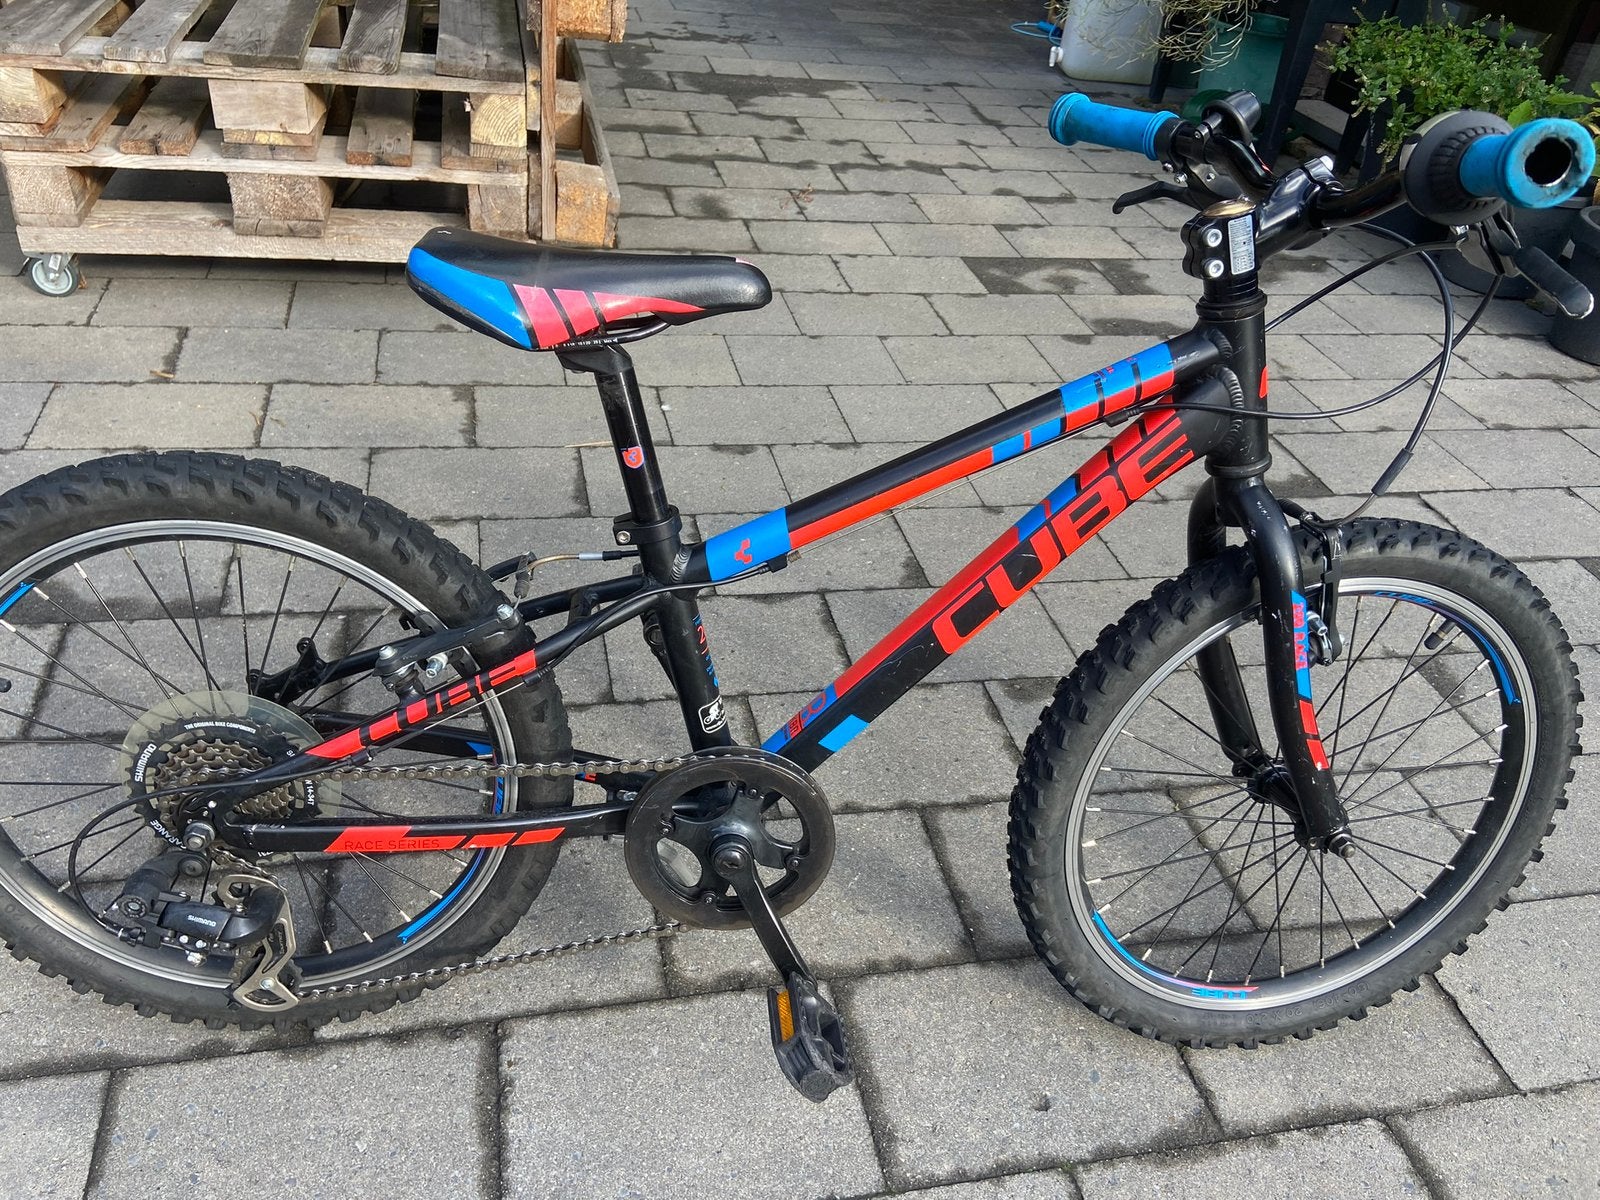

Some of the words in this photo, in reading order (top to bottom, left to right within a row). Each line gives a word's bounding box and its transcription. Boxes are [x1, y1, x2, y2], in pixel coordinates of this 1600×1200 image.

[931, 417, 1195, 655] CUBE
[194, 721, 215, 729] ORIGINAL
[134, 743, 157, 782] SHIMANO
[344, 840, 384, 850] RACE
[388, 839, 440, 849] SERIES
[187, 914, 217, 927] SHIMANO
[1191, 988, 1247, 999] CUBE
